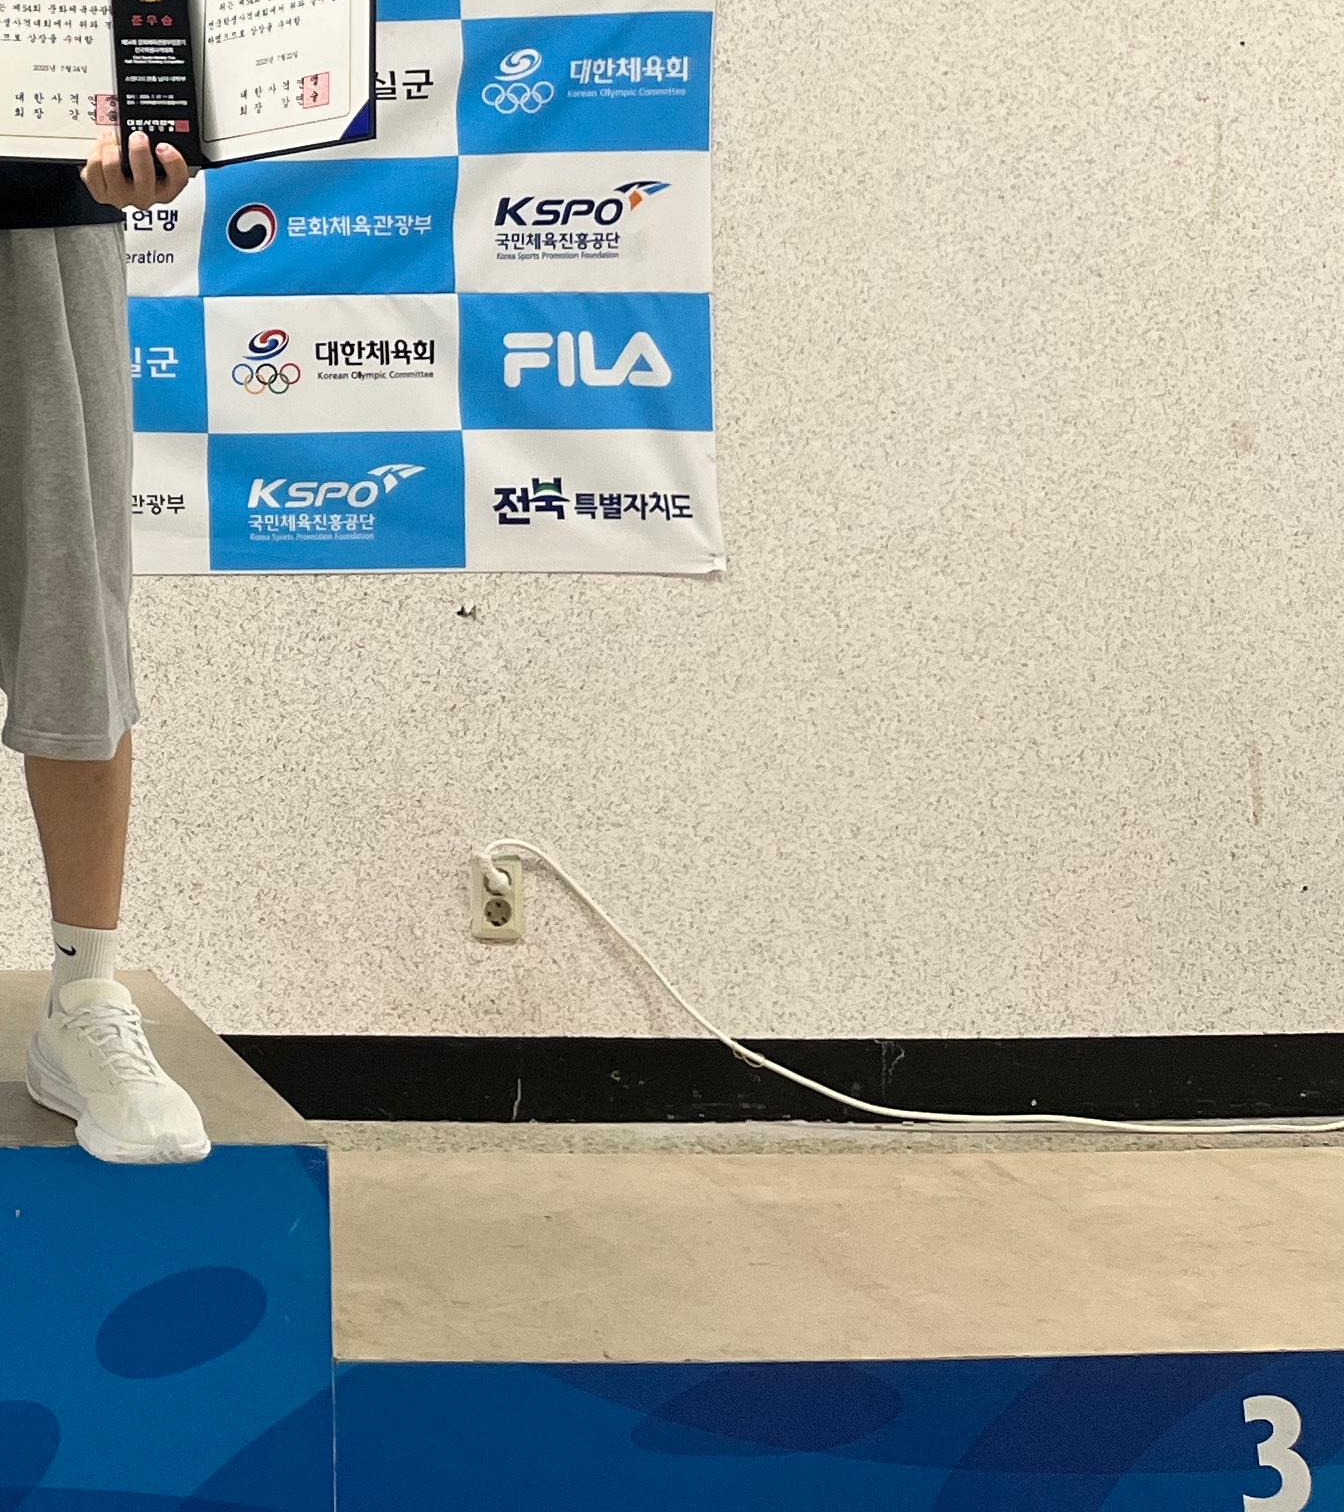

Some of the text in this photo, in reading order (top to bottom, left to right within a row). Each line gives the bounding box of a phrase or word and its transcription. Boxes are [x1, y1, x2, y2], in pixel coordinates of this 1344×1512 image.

[570, 56, 689, 82] 대한체육회
[375, 69, 433, 100] 실군
[495, 196, 623, 226] KSPO
[287, 215, 432, 238] 문화체육관광부
[495, 232, 620, 251] 국민체육진흥공단
[496, 250, 619, 260] Korea Sports Promotion Foundation
[314, 339, 435, 367] 대한체육회
[503, 331, 672, 388] FILA
[317, 370, 434, 381] Korean Olympic Committee
[247, 478, 381, 509] KSPO
[573, 491, 693, 522] 특별자치도
[248, 513, 375, 532] 국민체육진흥공단
[1243, 1395, 1312, 1512] 3
